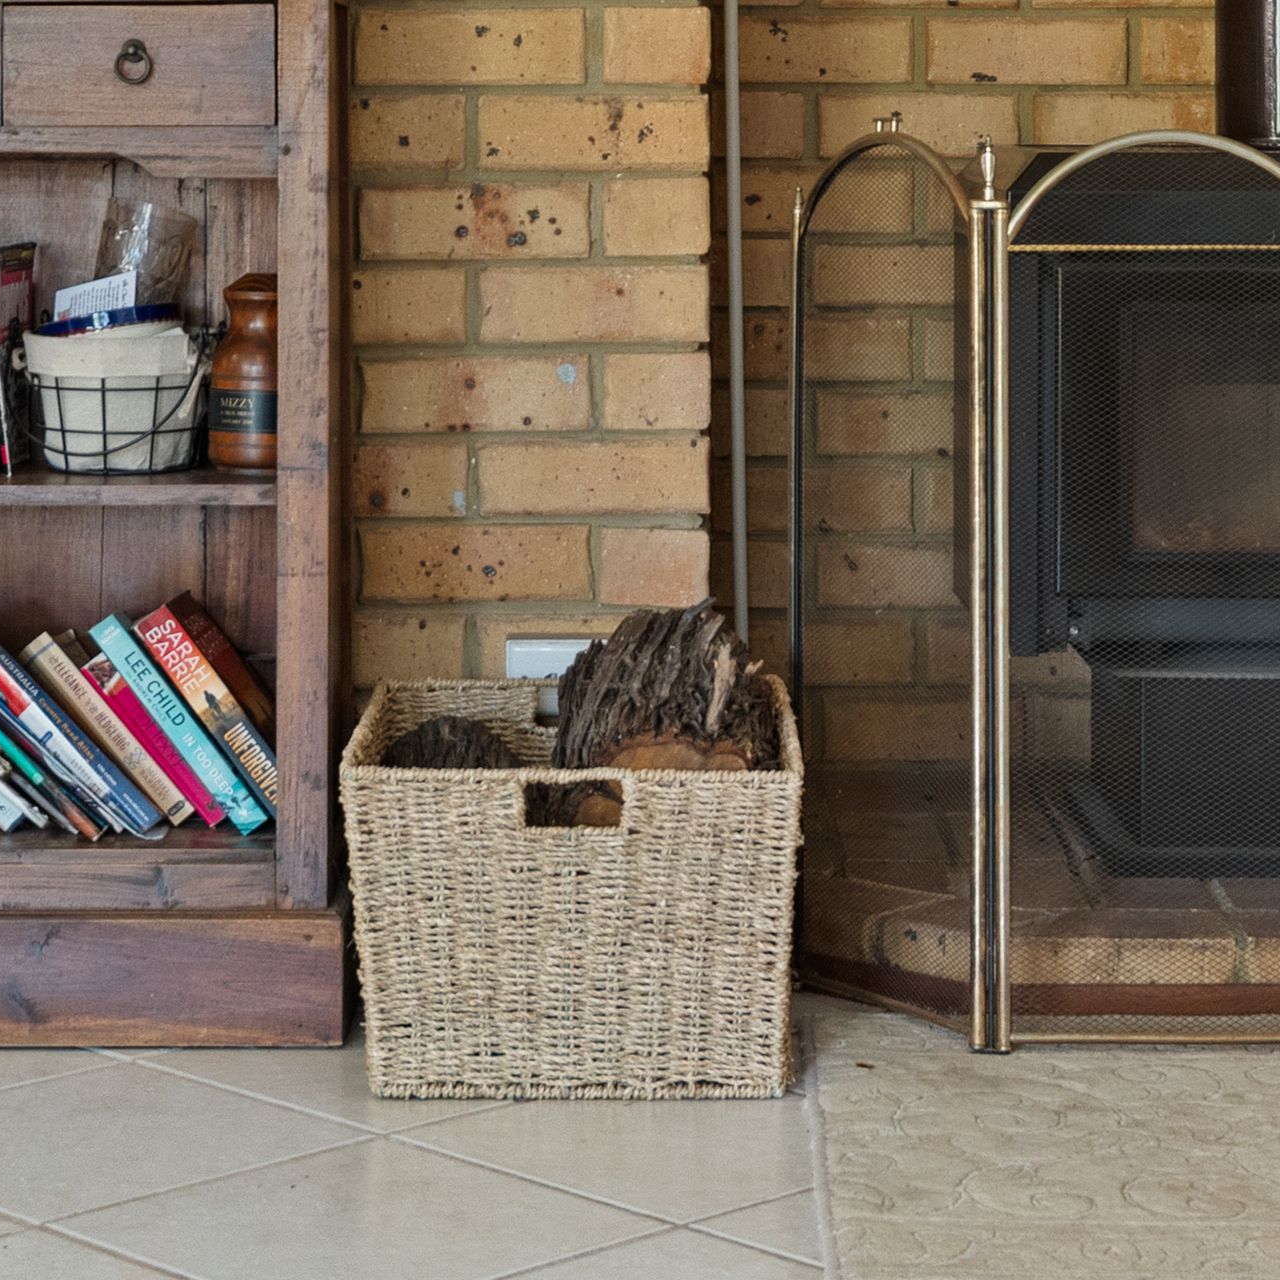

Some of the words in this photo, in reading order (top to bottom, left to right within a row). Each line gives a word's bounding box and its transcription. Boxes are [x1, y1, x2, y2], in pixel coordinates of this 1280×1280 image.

[220, 397, 256, 409] MIZZY
[145, 626, 200, 694] BARRIE
[160, 619, 211, 681] SARAH
[38, 697, 63, 724] Country
[61, 722, 81, 744] Road
[54, 659, 88, 700] ELEGANCE
[94, 711, 131, 752] HEDGEHOG
[124, 650, 152, 682] LEE
[147, 680, 186, 726] CHILD
[182, 732, 194, 747] IN
[193, 745, 213, 769] TOO
[209, 767, 234, 796] DEEP
[132, 678, 152, 706] ANDREW
